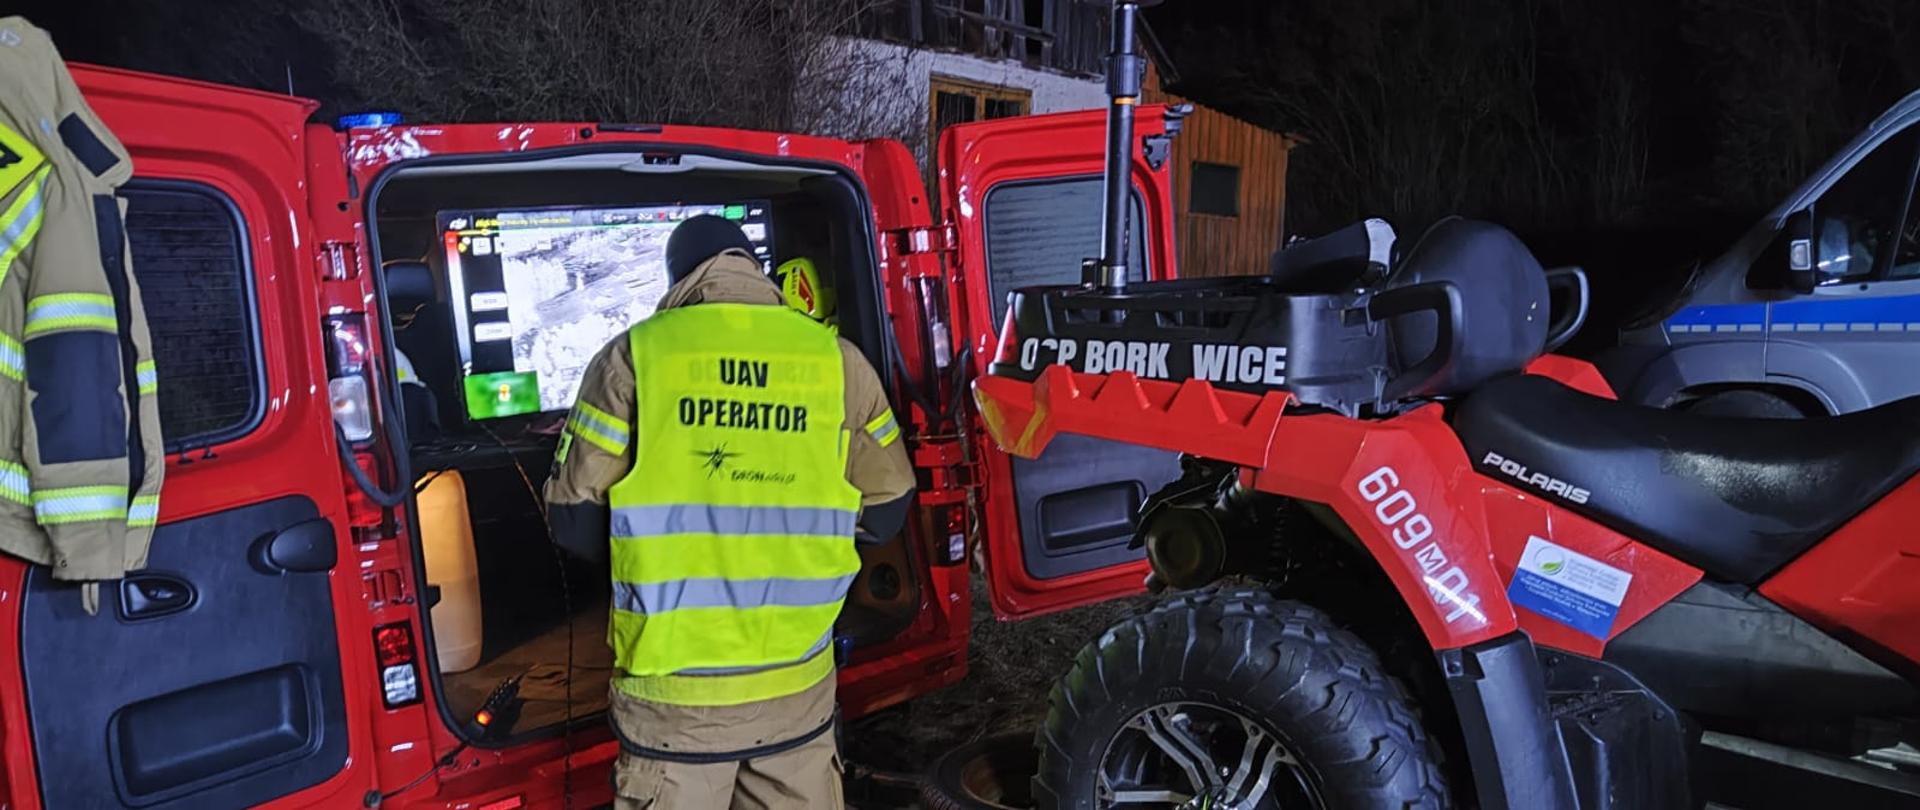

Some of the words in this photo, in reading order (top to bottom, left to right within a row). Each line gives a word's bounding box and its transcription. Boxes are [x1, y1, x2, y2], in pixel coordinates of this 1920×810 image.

[719, 357, 768, 388] UAV
[679, 397, 807, 432] OPERATOR
[1482, 451, 1591, 504] POLARIS
